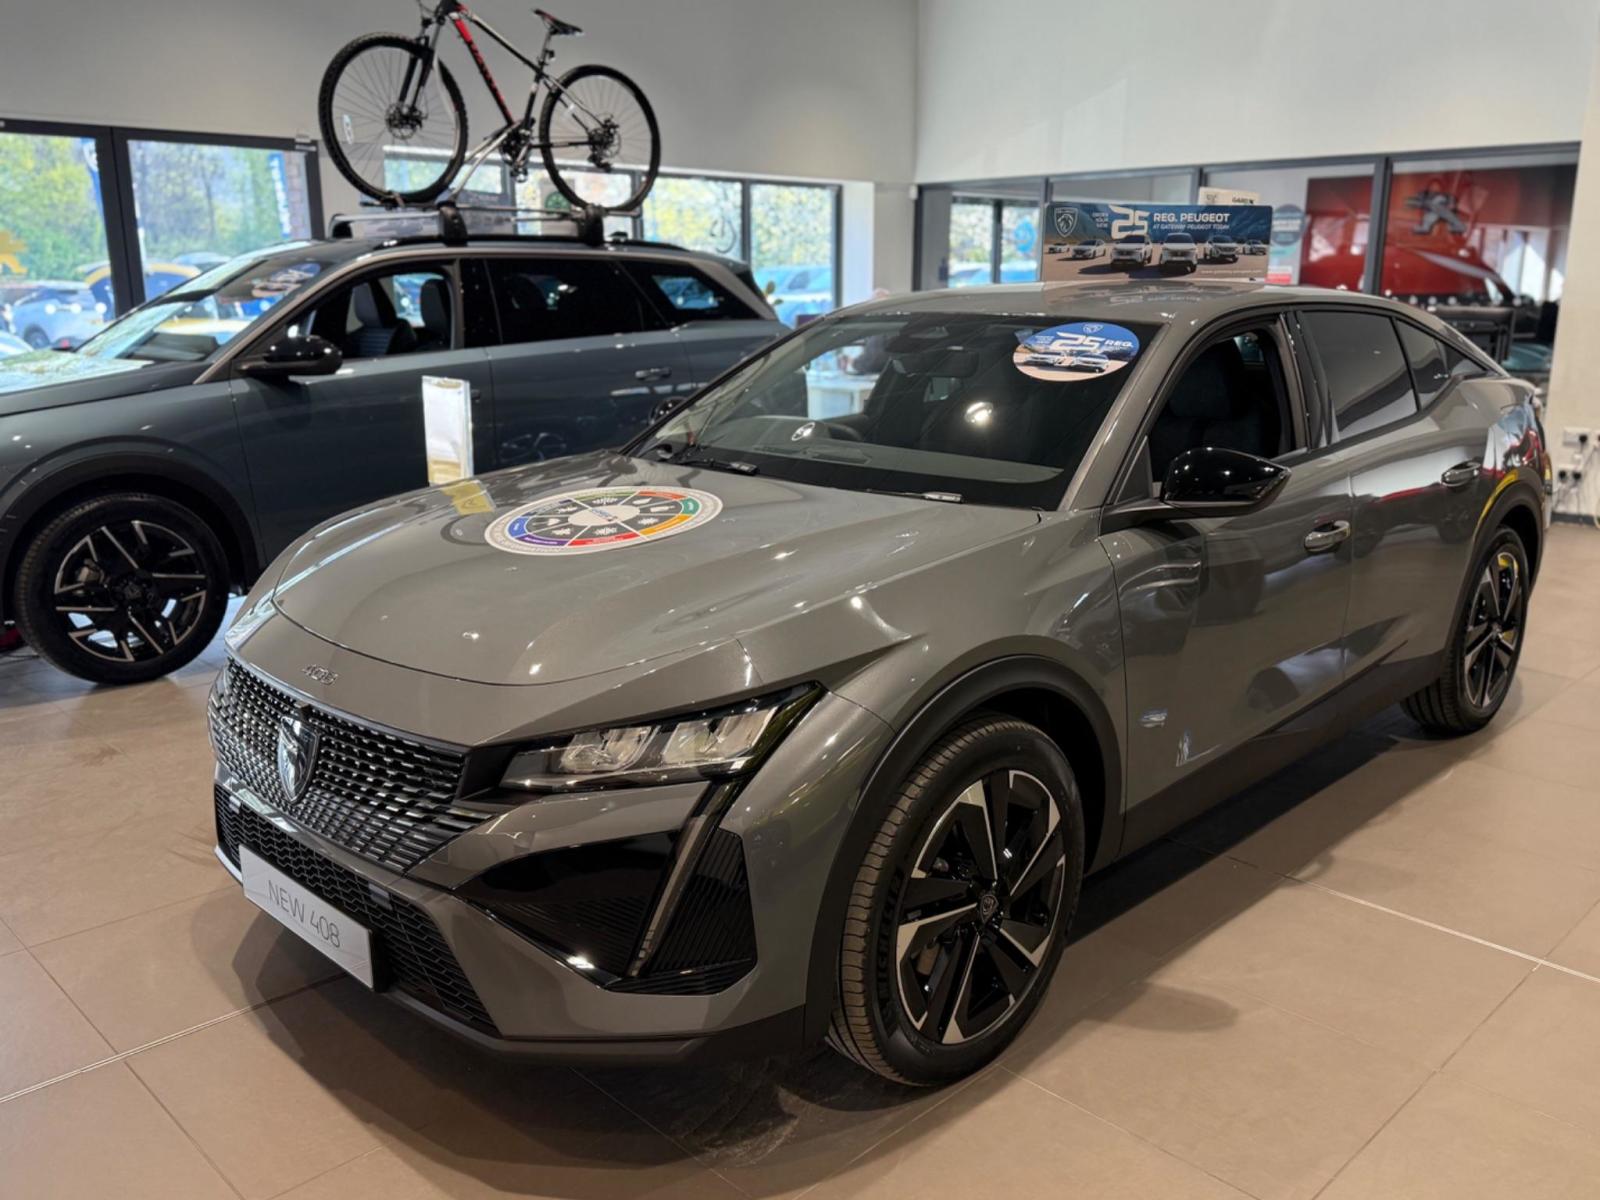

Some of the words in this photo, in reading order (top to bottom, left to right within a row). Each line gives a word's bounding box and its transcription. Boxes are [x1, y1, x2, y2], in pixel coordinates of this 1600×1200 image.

[1109, 203, 1151, 240] 25
[1153, 212, 1178, 223] REG.
[1180, 212, 1231, 223] PEUGEOT
[1051, 331, 1106, 351] 25
[267, 879, 306, 923] NEW
[309, 911, 341, 948] 408
